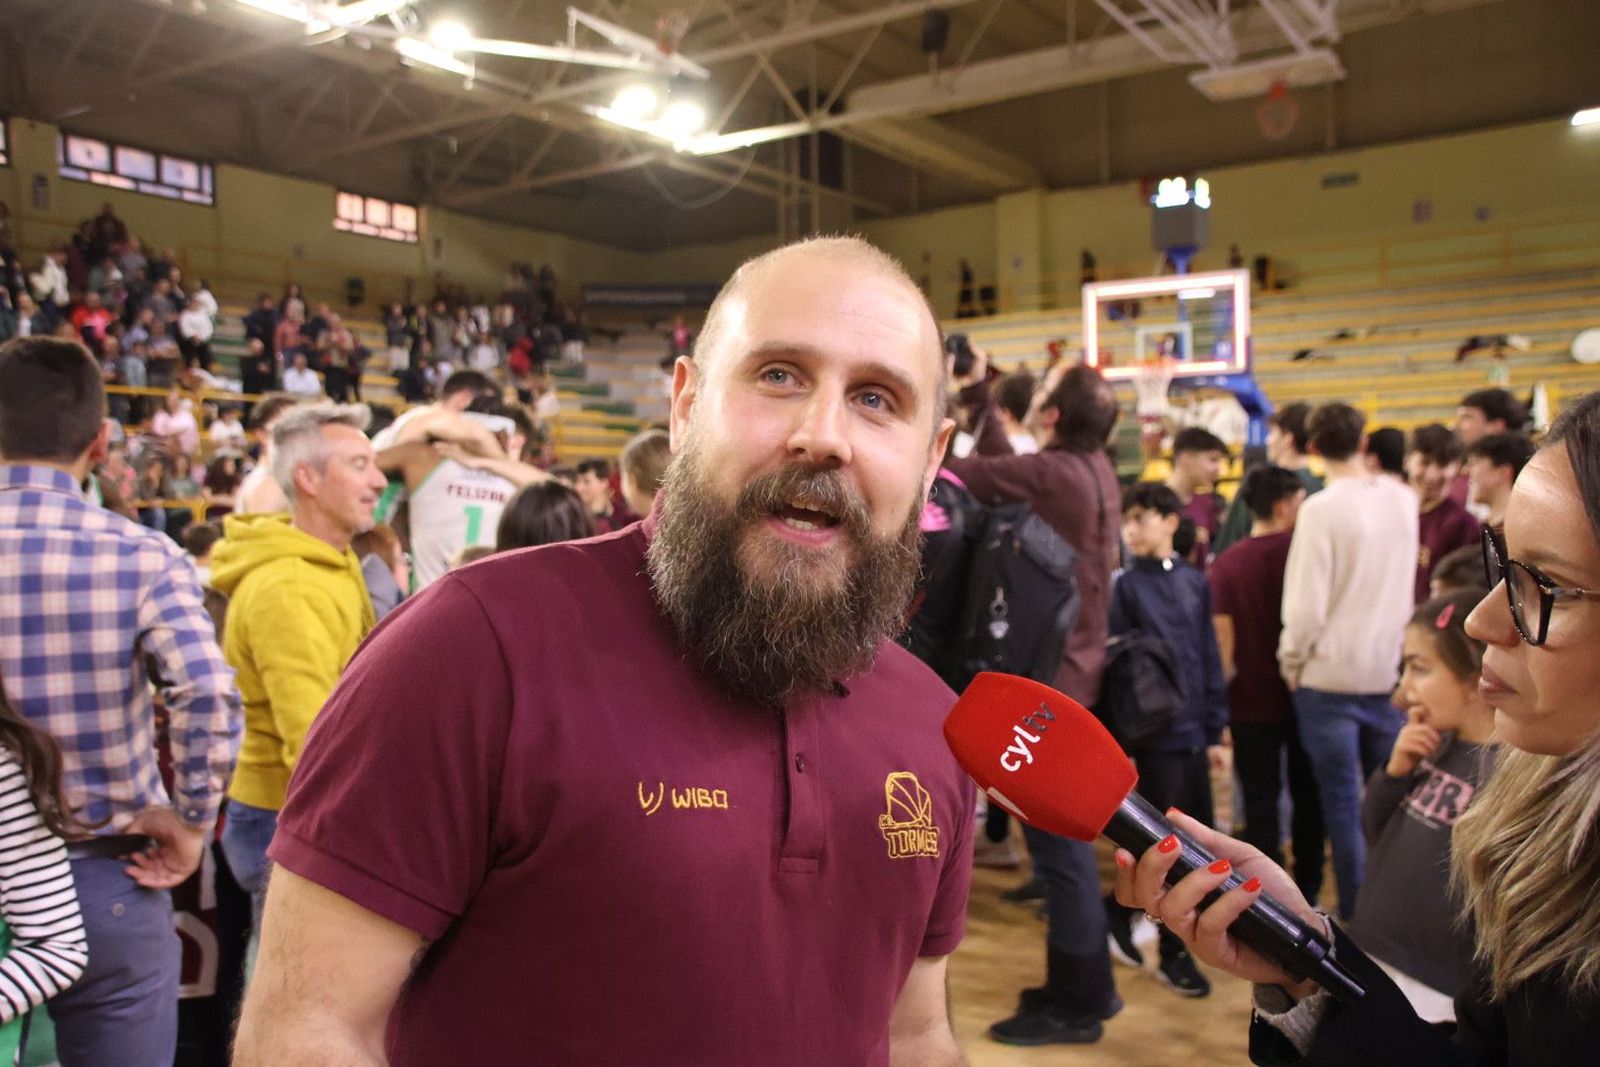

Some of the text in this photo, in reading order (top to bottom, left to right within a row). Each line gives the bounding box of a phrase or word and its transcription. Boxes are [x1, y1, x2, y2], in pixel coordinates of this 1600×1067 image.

[464, 505, 483, 545] 1
[672, 787, 728, 809] WIBO
[886, 829, 938, 855] TORMES
